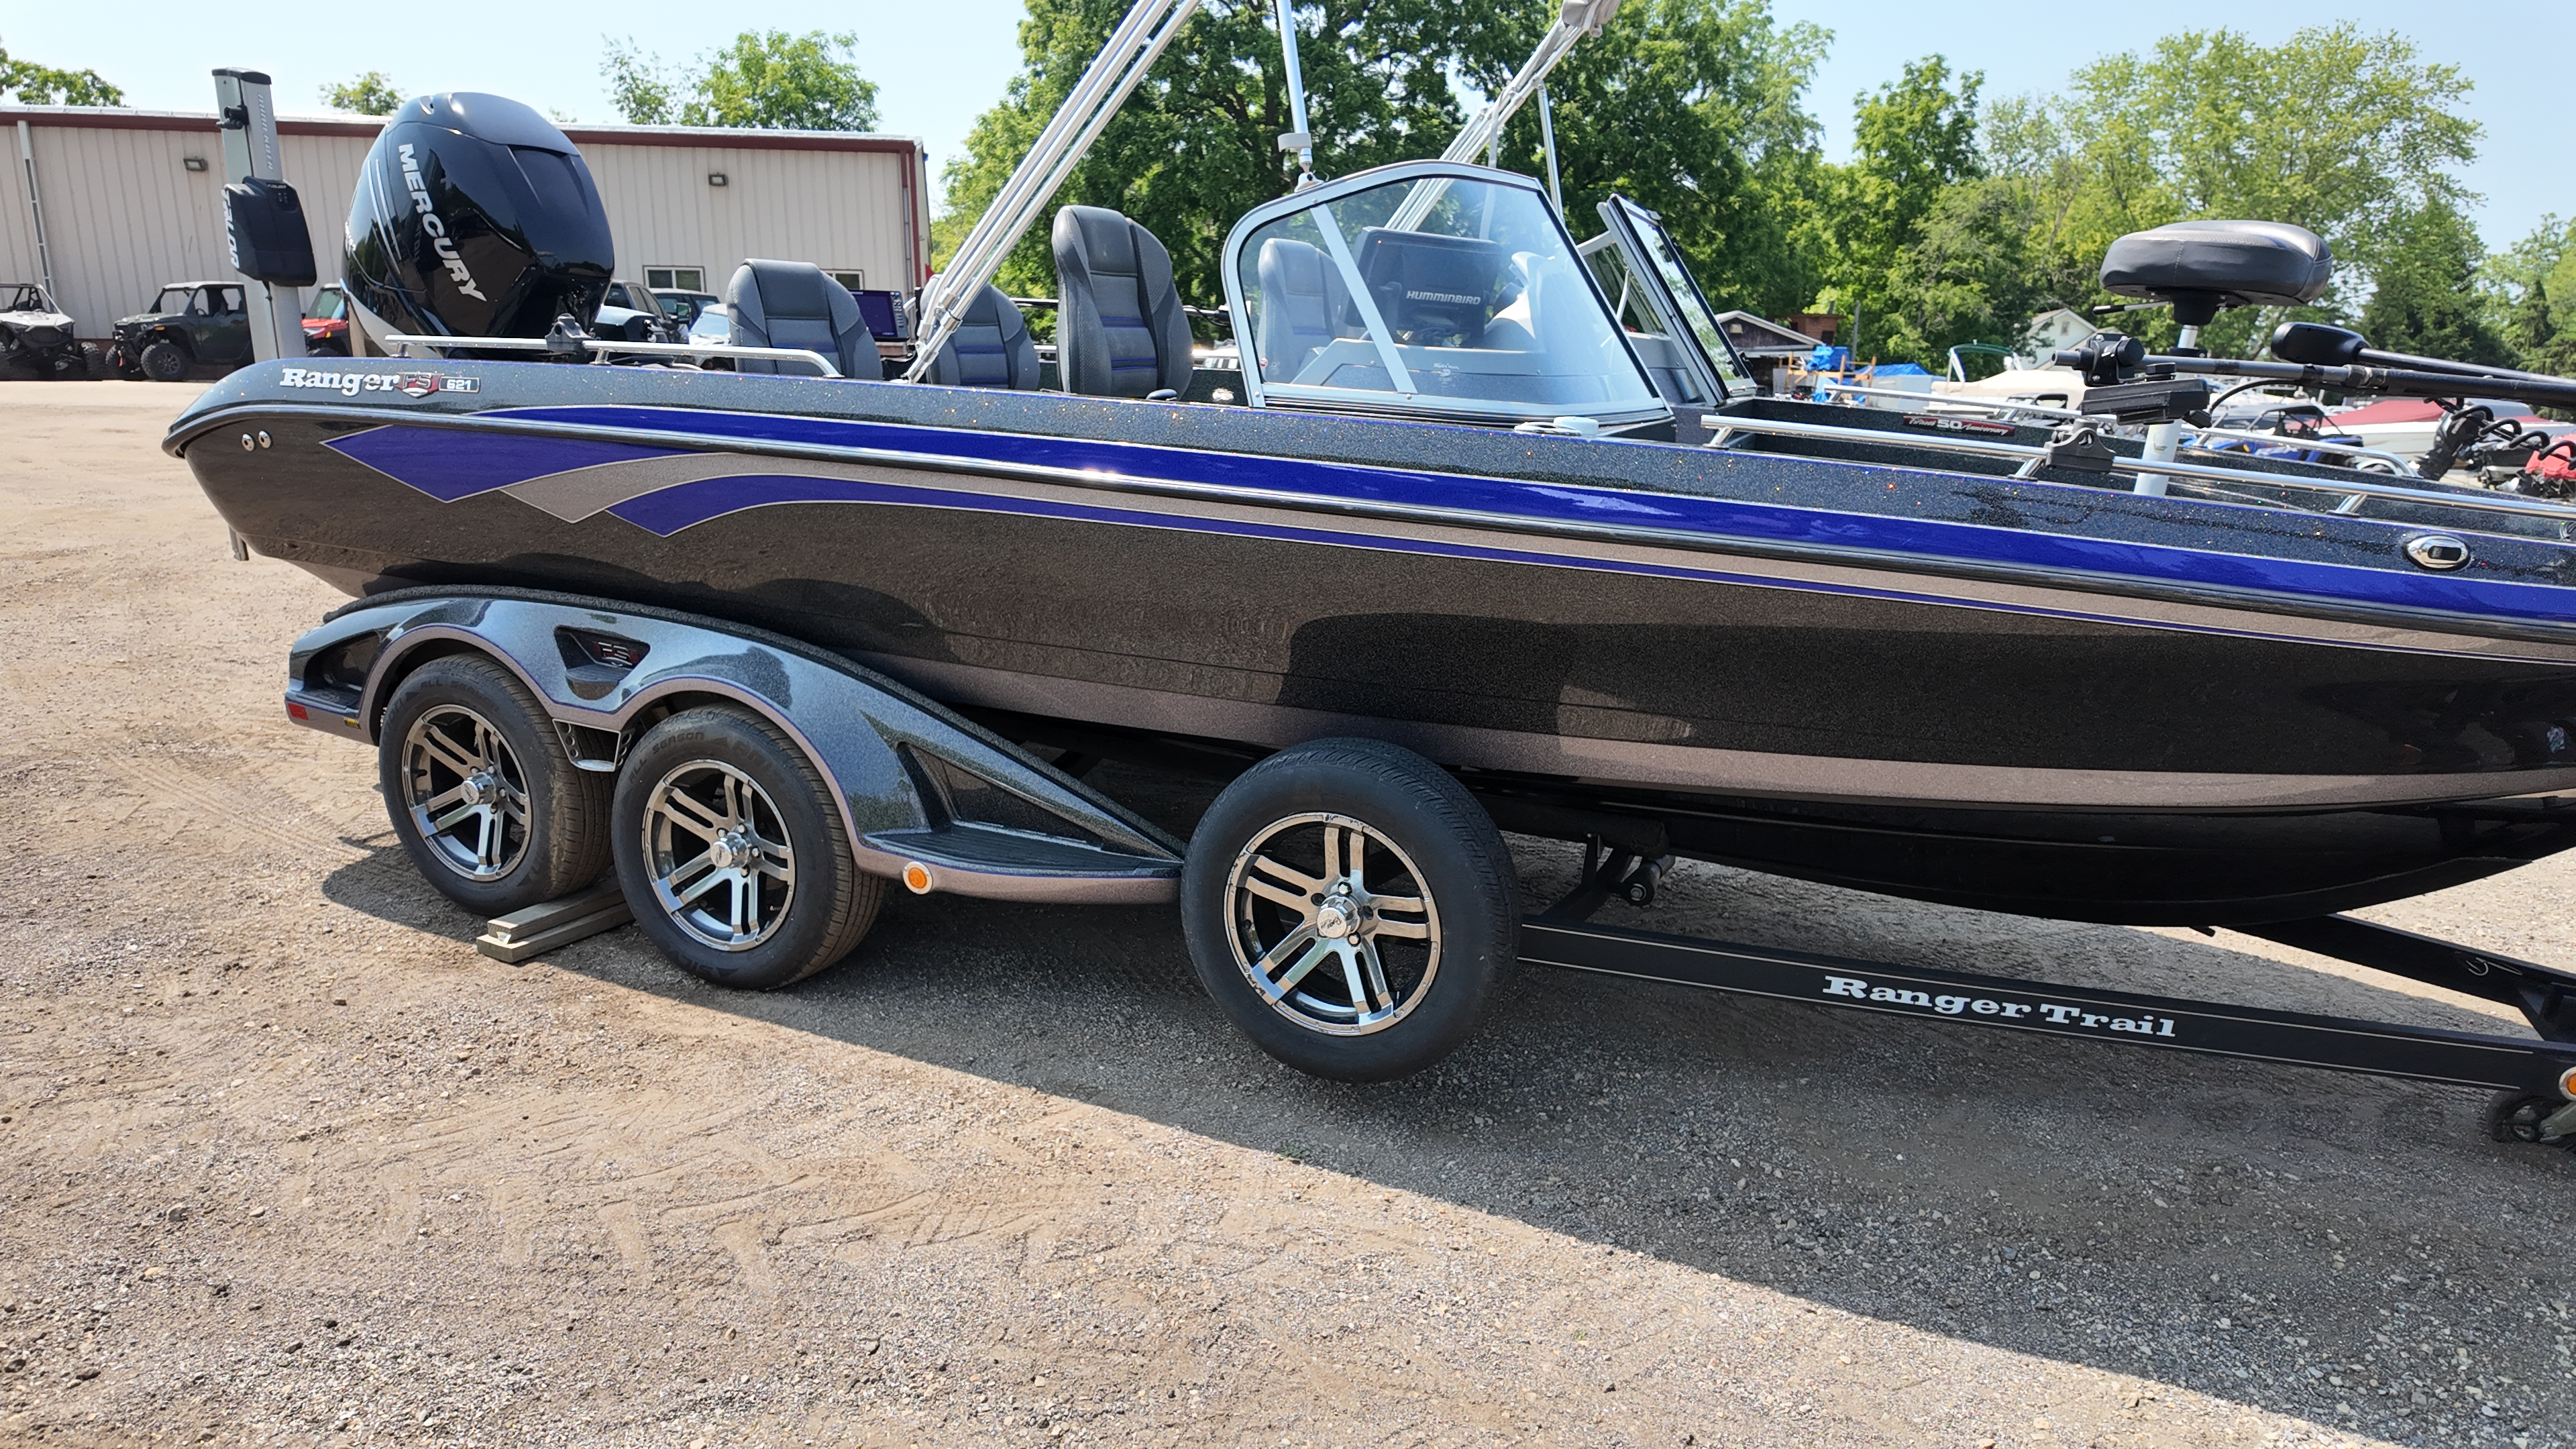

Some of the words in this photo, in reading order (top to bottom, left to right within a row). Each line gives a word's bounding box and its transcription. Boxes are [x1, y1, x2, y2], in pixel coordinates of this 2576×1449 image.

[221, 189, 239, 269] TALON
[398, 144, 487, 302] MERCURY
[1406, 290, 1481, 305] HUMMINBIRD
[279, 368, 400, 396] Ranger
[446, 378, 472, 390] 621
[1937, 419, 1963, 429] 50
[1823, 975, 2031, 1018] Ranger
[2039, 1004, 2176, 1037] Trail
